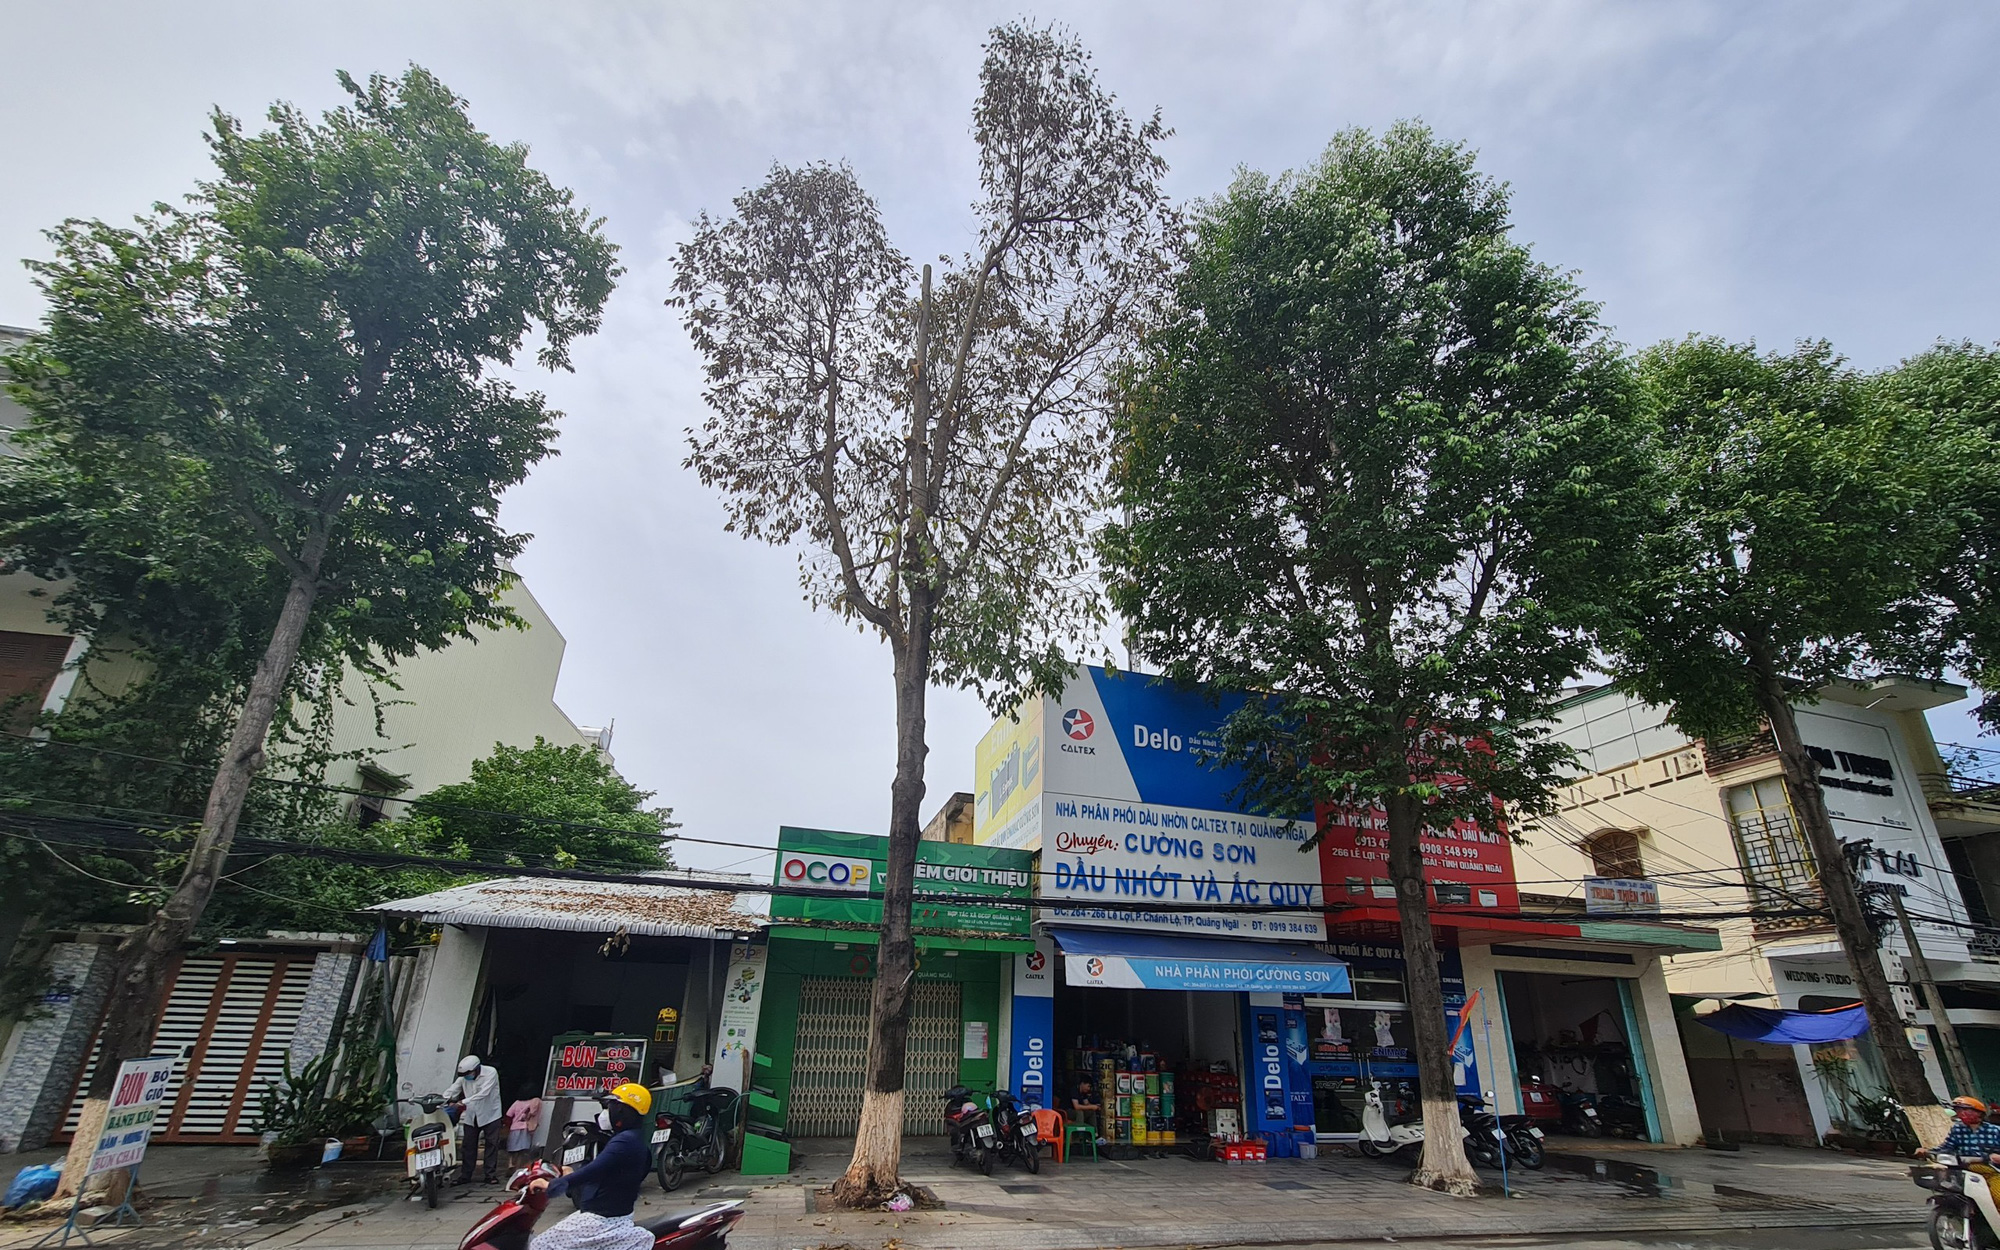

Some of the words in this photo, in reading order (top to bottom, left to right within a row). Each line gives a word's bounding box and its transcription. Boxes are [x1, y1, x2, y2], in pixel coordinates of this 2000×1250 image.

[1061, 744, 1096, 756] CALTEX
[1134, 724, 1182, 752] Delo
[1056, 800, 1077, 818] NHÀ
[1081, 803, 1109, 821] PHÂN
[1162, 811, 1188, 830] NHỜN
[1191, 816, 1228, 834] CALTEX
[1231, 821, 1246, 838] TẠI
[1056, 832, 1119, 855] Chuyên:
[1125, 831, 1204, 859] CƯỜNG
[1212, 842, 1256, 864] SƠN
[1420, 842, 1442, 855] 0908
[1444, 845, 1461, 856] 548
[1462, 848, 1478, 859] 999
[784, 858, 868, 886] OCOP
[913, 857, 940, 879] ỂM
[943, 863, 978, 883] GIỚI
[981, 868, 1028, 890] THIỆU
[1332, 847, 1348, 857] 266
[1350, 848, 1360, 858] LÊ
[1460, 860, 1484, 872] QUẢNG
[1485, 863, 1502, 874] NGÃI
[1055, 856, 1106, 892] DẦU
[1115, 864, 1182, 899] NHỚT
[1190, 870, 1222, 902] VÀ
[1230, 872, 1260, 904] ẮC
[1269, 882, 1313, 907] QUY
[1196, 917, 1220, 930] Quảng
[1222, 918, 1239, 931] Ngãi
[1269, 922, 1286, 932] 0919
[1289, 923, 1302, 932] 384
[1304, 924, 1317, 934] 639
[1376, 947, 1392, 958] QUY
[1394, 950, 1401, 959] &
[1155, 964, 1182, 978] NHÀ
[1186, 965, 1220, 979] PHÂN
[1256, 967, 1301, 981] CƯỜNG
[1304, 970, 1330, 982] SƠN
[1784, 970, 1820, 983] WEDDING
[1825, 973, 1852, 985] STUDIO
[562, 1040, 597, 1068] BÚN
[1023, 1038, 1043, 1086] Delo
[1262, 1045, 1282, 1089] Delo
[115, 1066, 148, 1107] BÚN
[556, 1072, 597, 1090] BÁNH
[107, 1112, 136, 1130] BÁNH
[116, 1146, 144, 1164] CHAY
